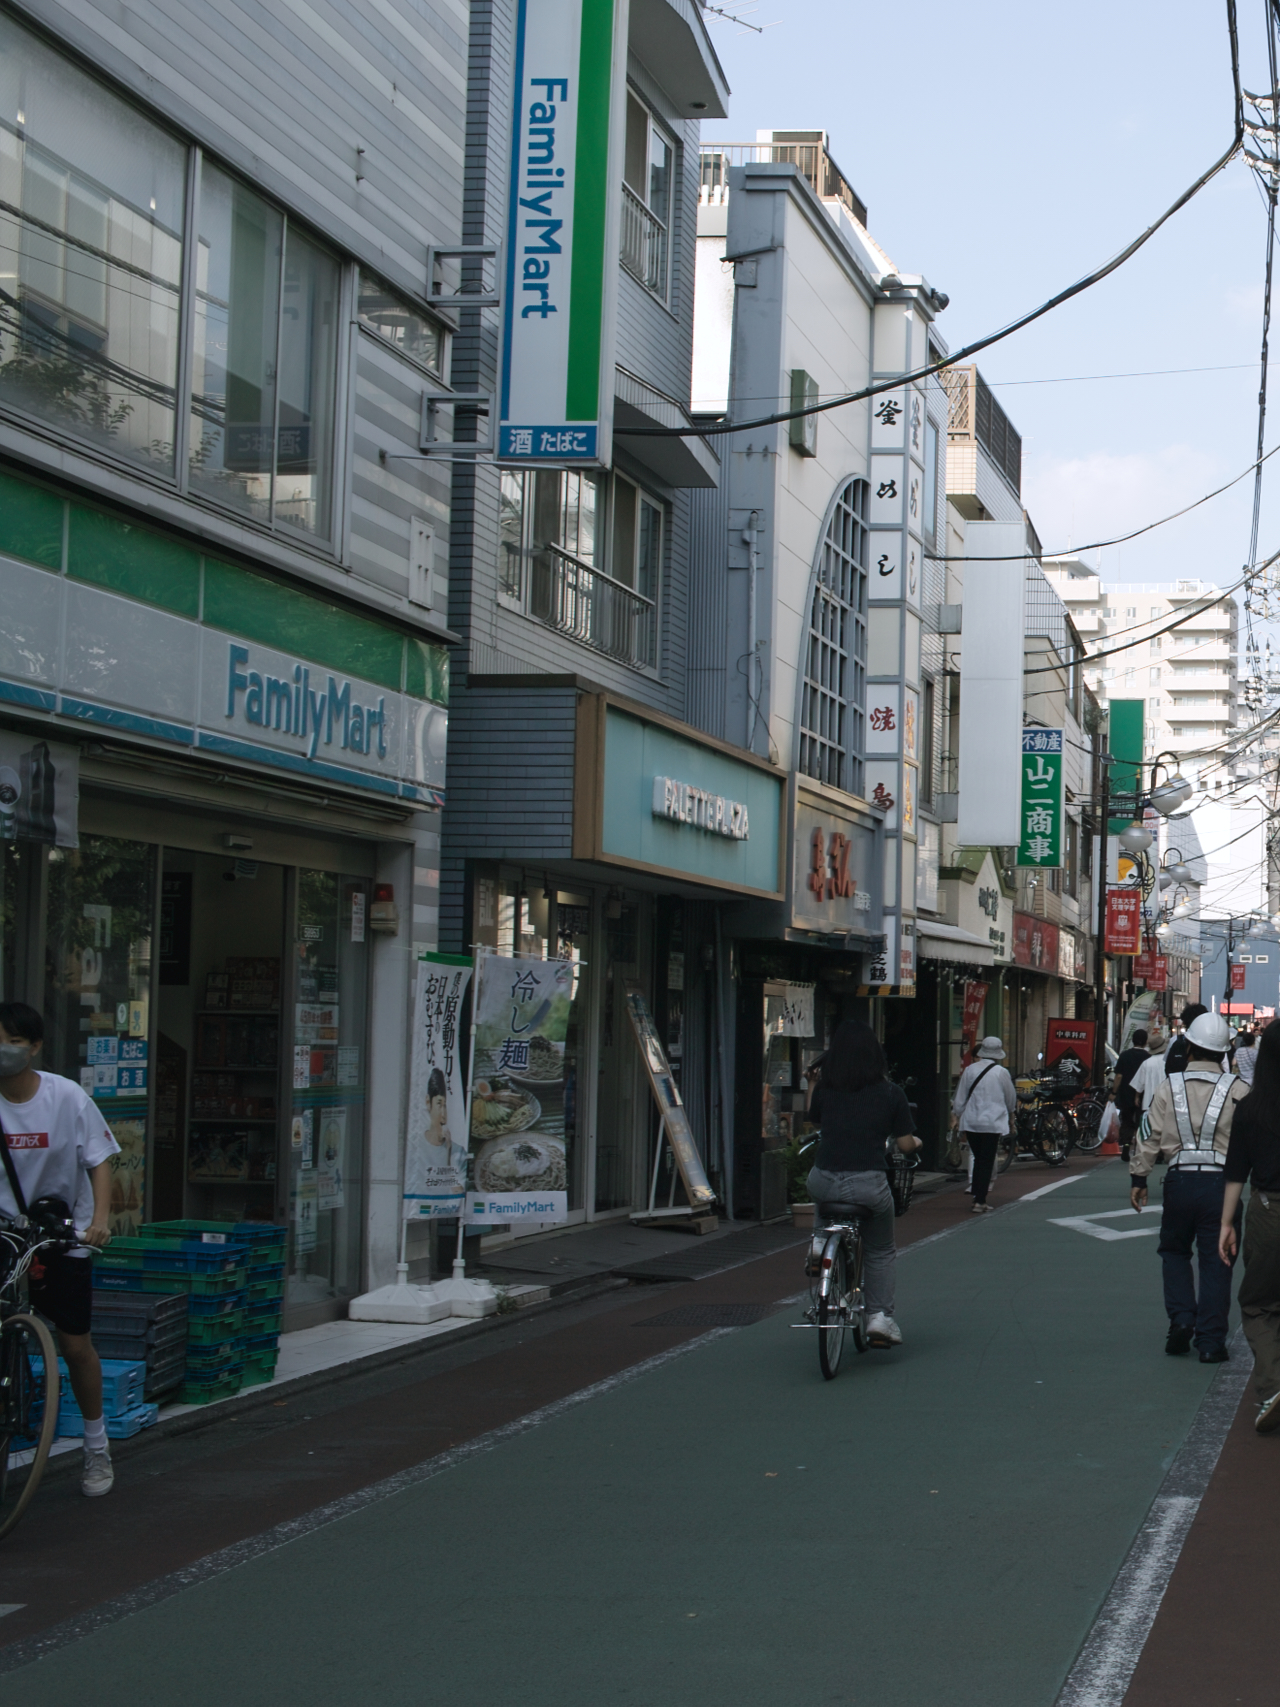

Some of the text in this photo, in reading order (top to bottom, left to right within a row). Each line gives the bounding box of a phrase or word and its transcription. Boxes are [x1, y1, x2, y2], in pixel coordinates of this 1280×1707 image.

[519, 78, 568, 319] FamilyMart
[509, 429, 587, 454] 酒 たばこ
[874, 399, 903, 577] 釜めし
[225, 642, 387, 758] FamilyMart
[869, 706, 896, 811] 焼鳥
[1022, 732, 1061, 751] 不動産
[1024, 755, 1055, 863] 山二商事
[1111, 897, 1136, 905] 日本大学
[434, 975, 448, 1034] 日本の
[499, 969, 541, 1071] 冷し麺
[121, 1041, 144, 1059] たばこ
[1056, 1029, 1087, 1040] 中華料理
[488, 1201, 555, 1214] FamilyMart
